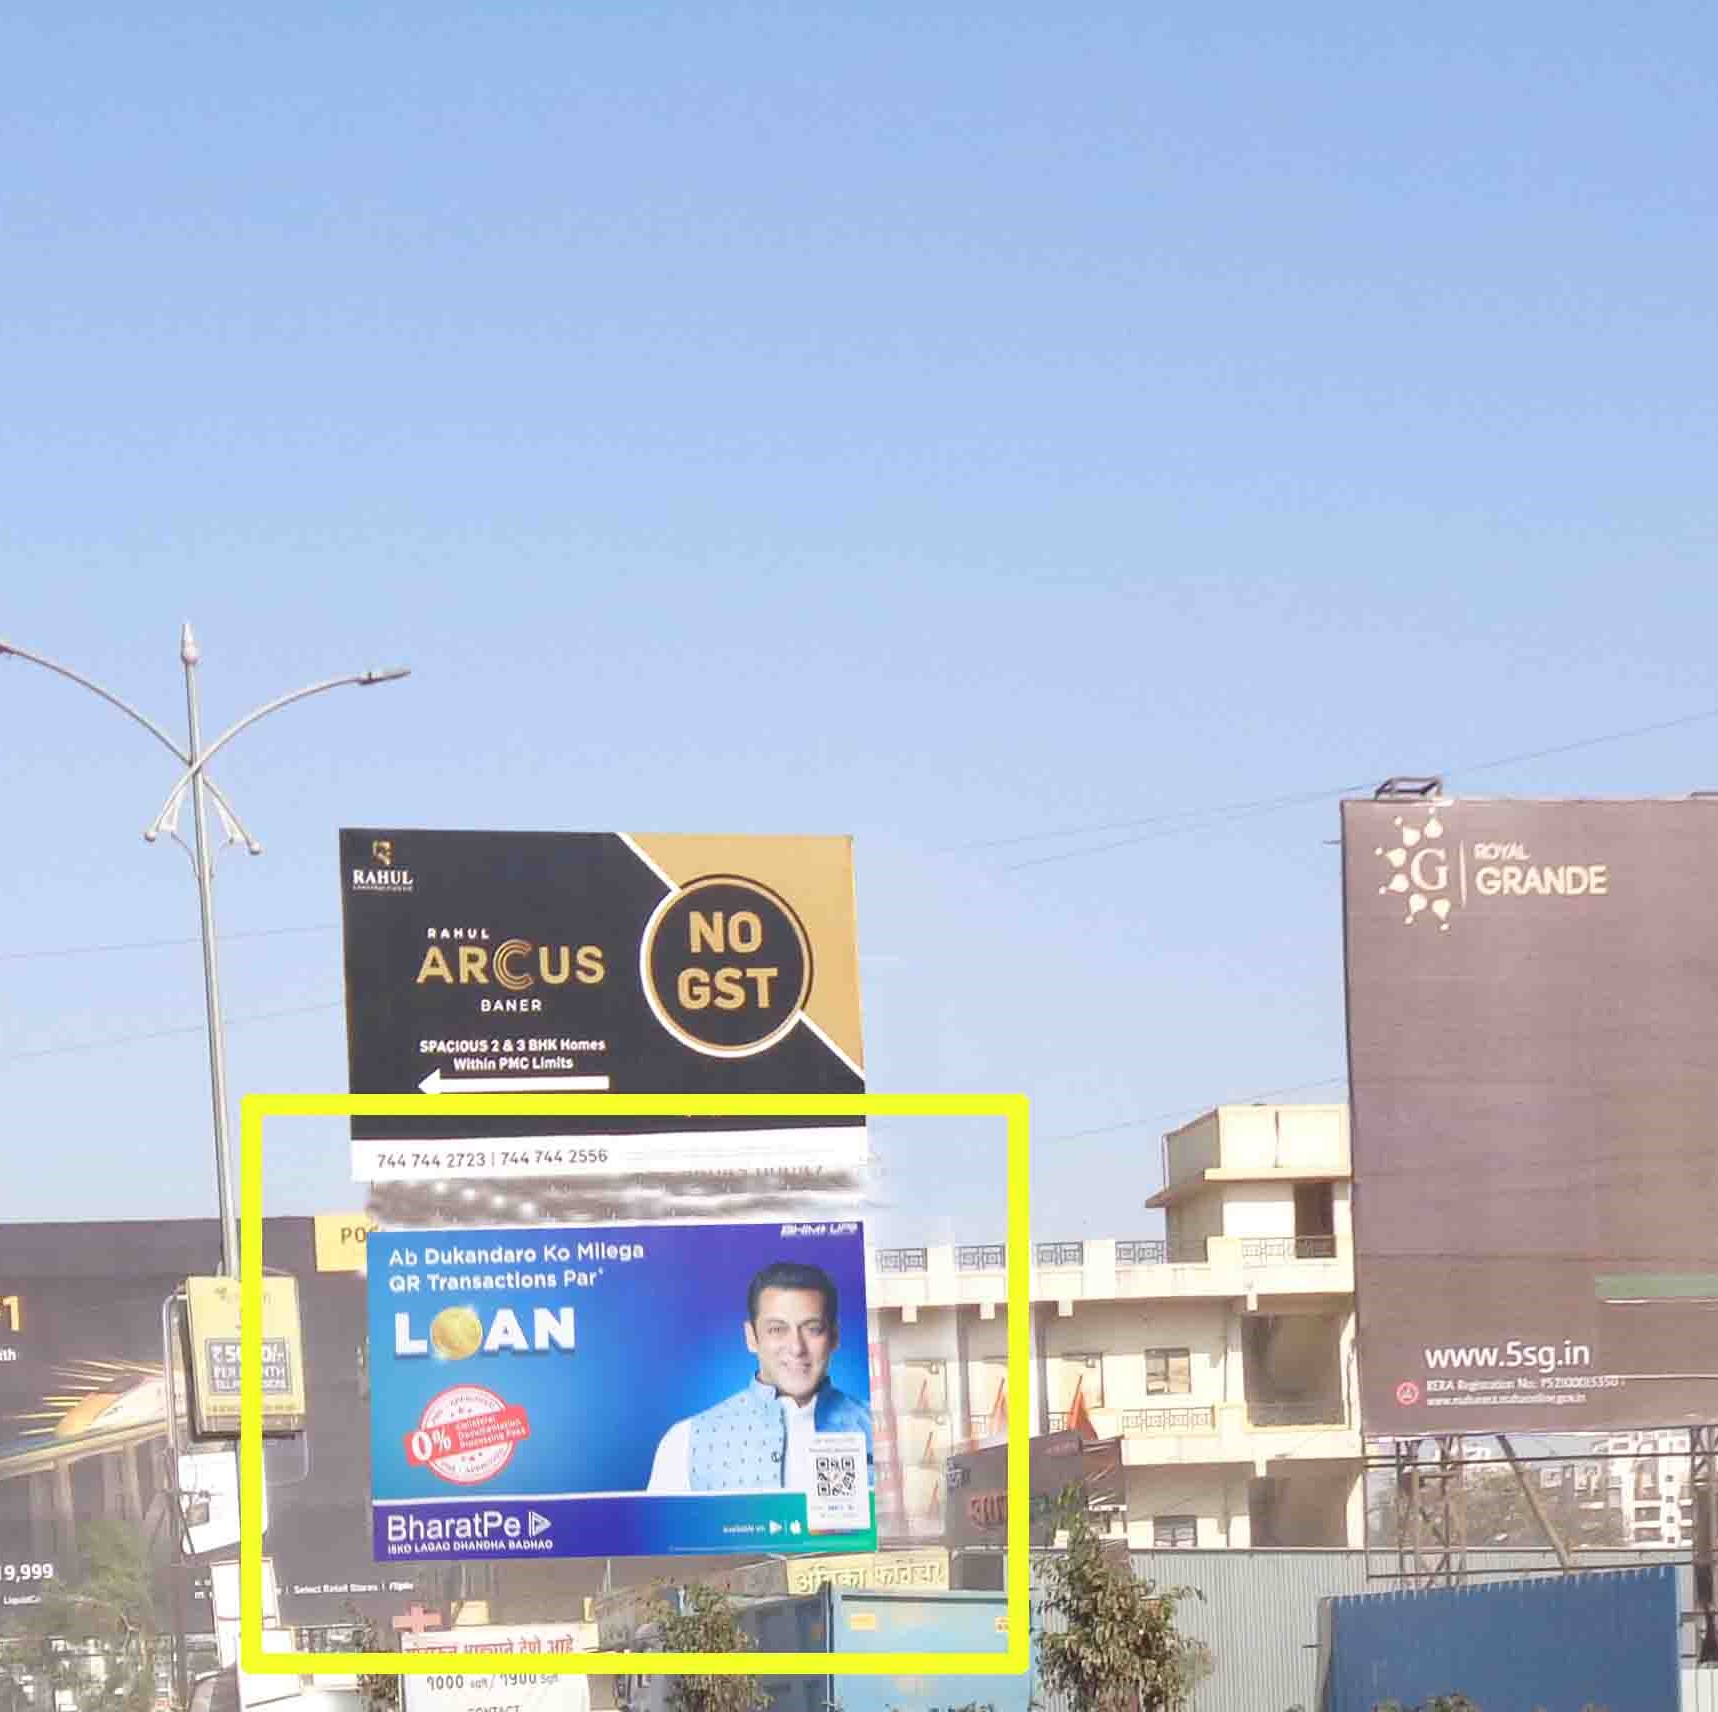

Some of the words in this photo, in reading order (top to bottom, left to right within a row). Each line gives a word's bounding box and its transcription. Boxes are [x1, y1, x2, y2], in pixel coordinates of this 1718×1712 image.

[1474, 842, 1530, 861] ROYAL
[353, 869, 414, 886] RAHUL
[1475, 864, 1609, 896] GRANDE
[427, 928, 491, 940] RAHUL
[689, 911, 763, 954] NO
[415, 938, 606, 992] ARCUS
[677, 967, 779, 1010] GST
[480, 998, 543, 1013] BANER
[419, 1040, 488, 1055] SPACIOUS
[490, 1040, 500, 1053] 2
[516, 1039, 526, 1053] 3
[528, 1038, 558, 1052] BHK
[560, 1038, 606, 1052] Homes
[453, 1056, 497, 1072] Within
[499, 1056, 529, 1072] PMC
[532, 1055, 574, 1071] Limits
[389, 1248, 418, 1267] Ab
[424, 1247, 537, 1266] Dukandaro
[543, 1244, 570, 1262] Ko
[577, 1242, 644, 1263] Milega
[389, 1273, 421, 1293] QR
[426, 1269, 557, 1292] Transactions
[394, 1306, 576, 1360] LOAN
[1424, 1340, 1591, 1373] www.5sg.in
[411, 1428, 452, 1462] 0%
[387, 1510, 522, 1542] BharatPe
